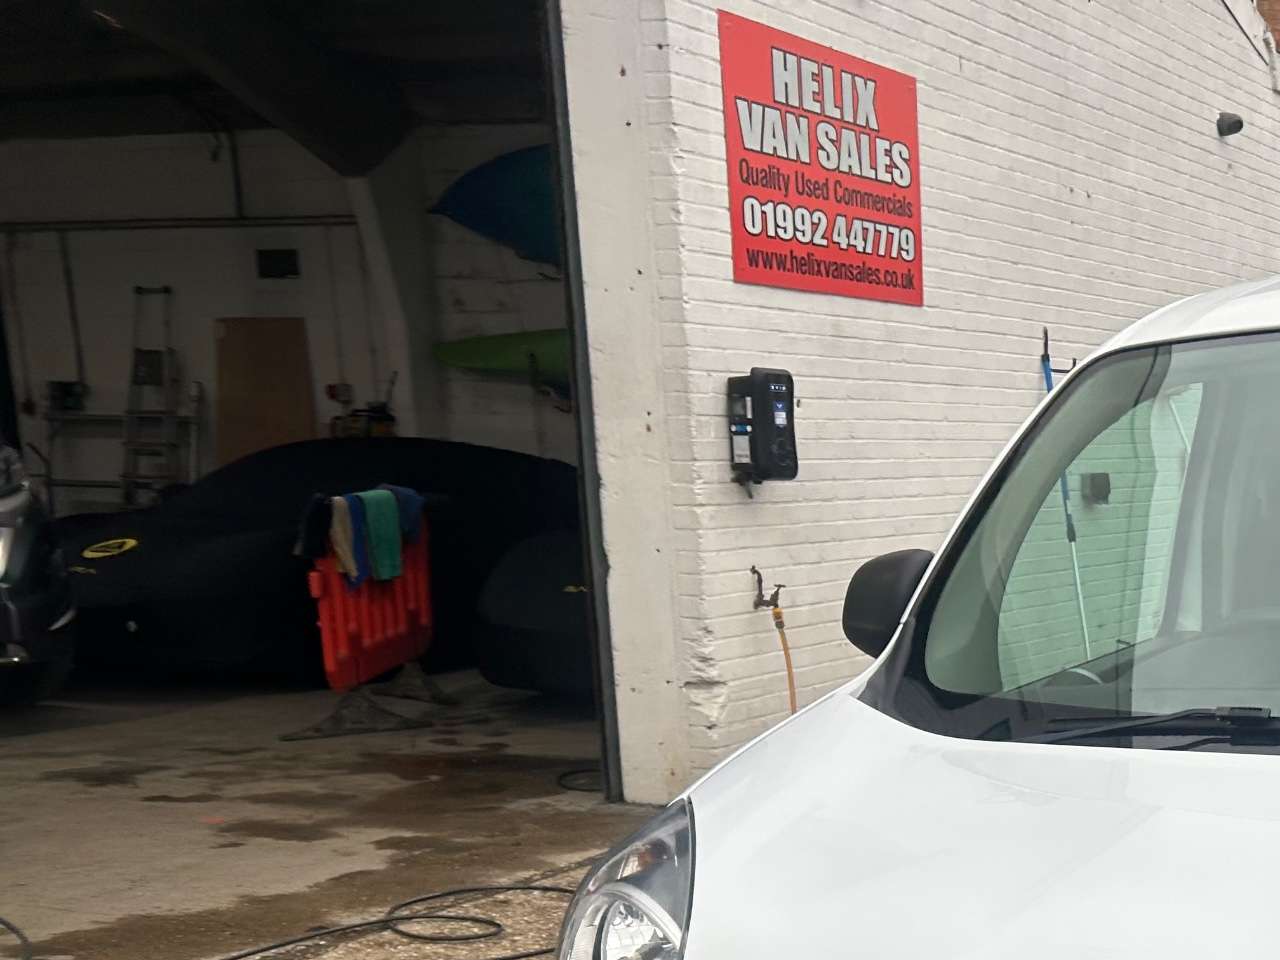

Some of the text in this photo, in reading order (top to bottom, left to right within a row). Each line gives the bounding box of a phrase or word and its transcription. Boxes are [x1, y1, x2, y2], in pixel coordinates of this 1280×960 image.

[771, 46, 879, 132] HELIX
[735, 96, 912, 188] VAN SALES
[739, 158, 913, 217] Quality Used Commercials
[743, 196, 916, 262] 01992 447779
[747, 247, 915, 290] www.helixvansales.co.uk
